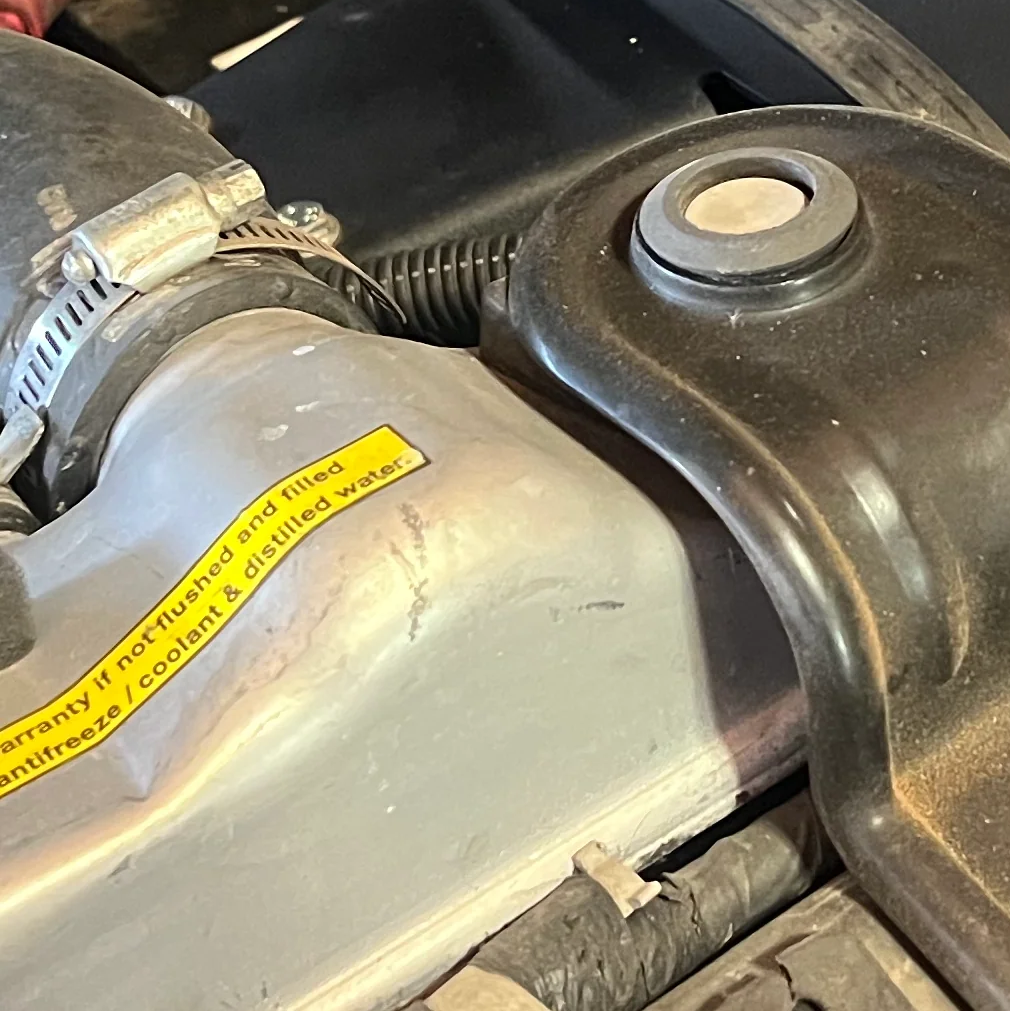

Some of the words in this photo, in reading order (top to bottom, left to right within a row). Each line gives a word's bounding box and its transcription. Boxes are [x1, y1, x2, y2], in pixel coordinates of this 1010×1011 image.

[0, 691, 91, 754] arranty
[93, 669, 112, 691] if
[116, 625, 156, 671] not
[156, 545, 234, 631] flushed
[237, 500, 278, 544] and
[281, 461, 346, 501] filled
[0, 704, 122, 787] antifreeze
[125, 684, 133, 705] /
[139, 605, 223, 688] coolant
[223, 584, 243, 602] &
[244, 496, 332, 580] distilled
[334, 455, 412, 498] water.
